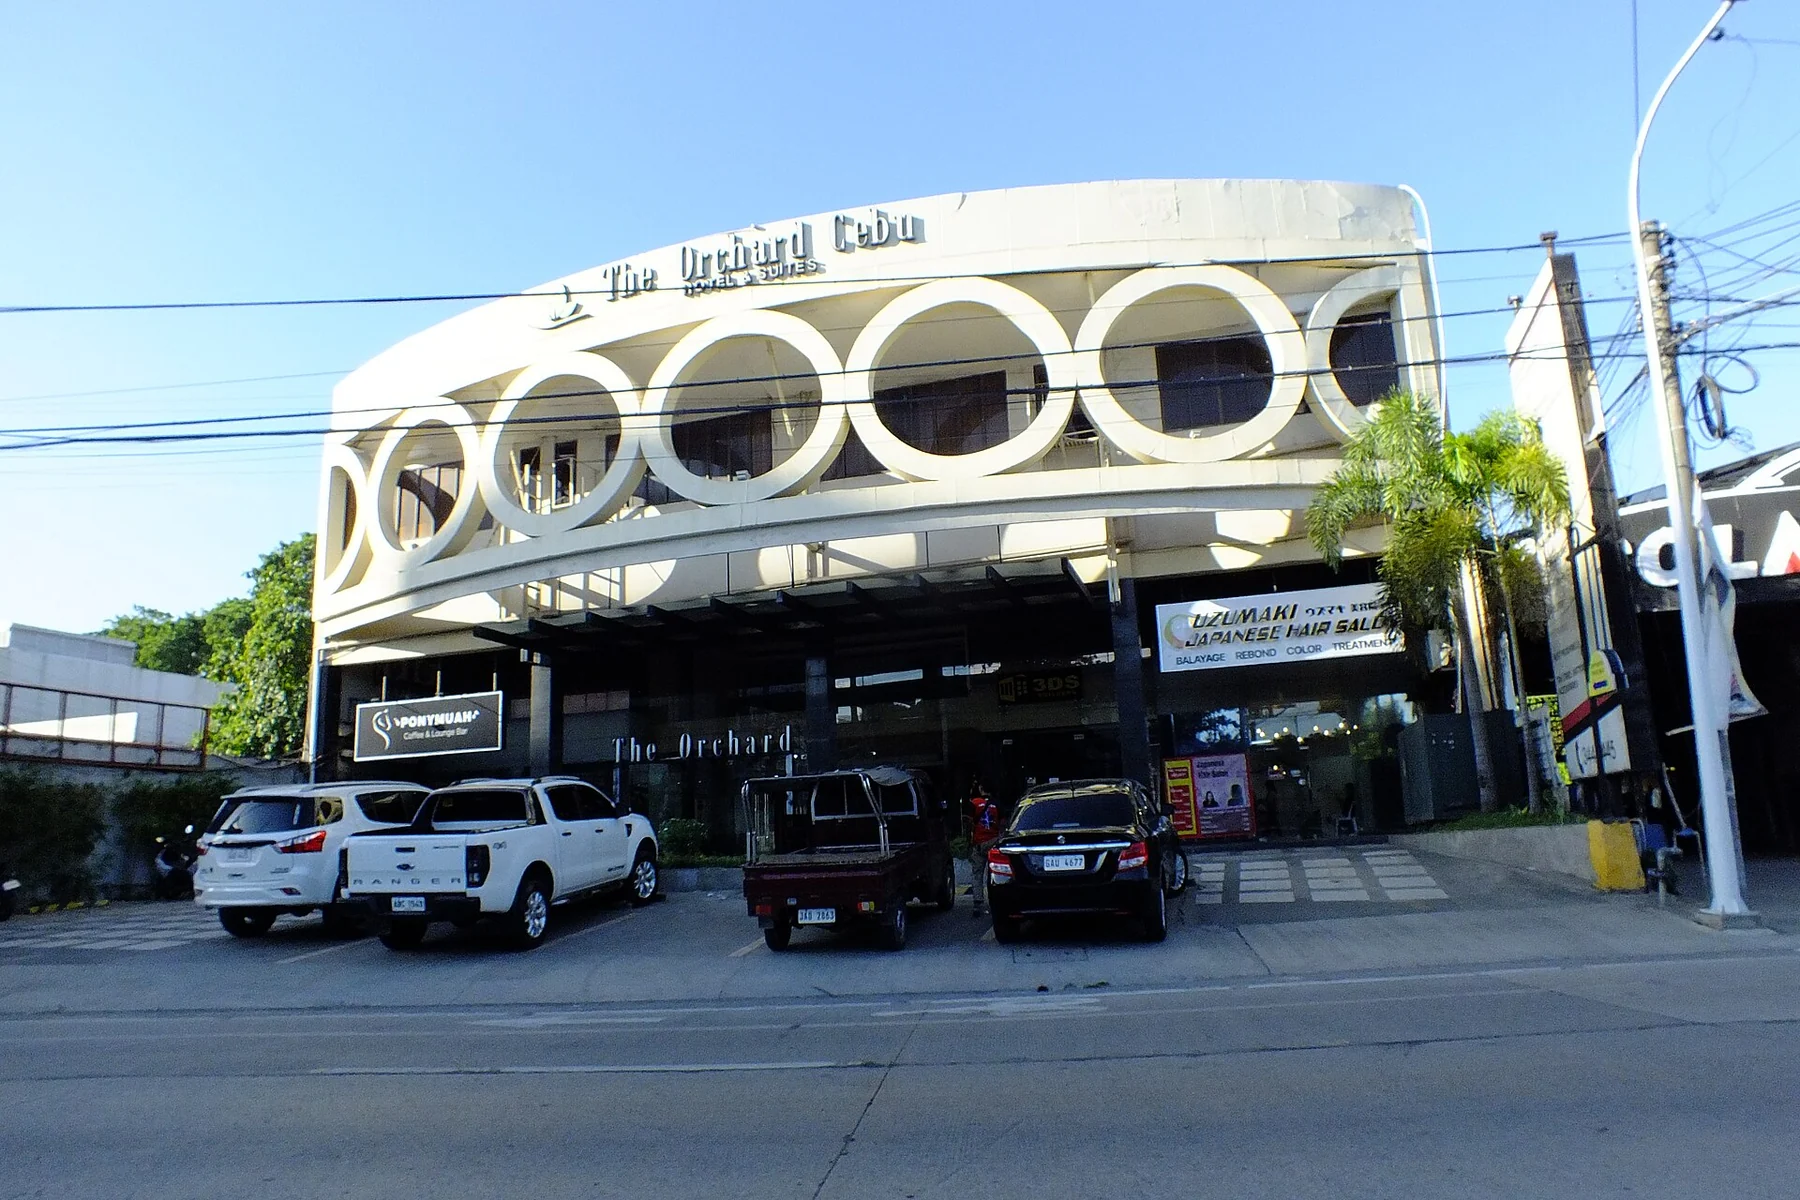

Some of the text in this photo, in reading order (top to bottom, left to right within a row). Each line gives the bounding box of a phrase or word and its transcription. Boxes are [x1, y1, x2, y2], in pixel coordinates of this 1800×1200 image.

[602, 208, 916, 301] The Orchard Cebu
[759, 259, 818, 281] SUITES
[1193, 604, 1298, 628] UZUMAKI
[1185, 625, 1282, 647] JAPANESE
[1286, 620, 1331, 638] HAIR
[1176, 638, 1391, 665] BALAYAGE REBOND COLOR TREATMEN
[400, 711, 472, 729] PONYMUAH
[403, 731, 425, 740] Coffee
[431, 728, 455, 739] Lounge
[612, 725, 790, 763] The Orchard
[353, 877, 461, 885] RANGER
